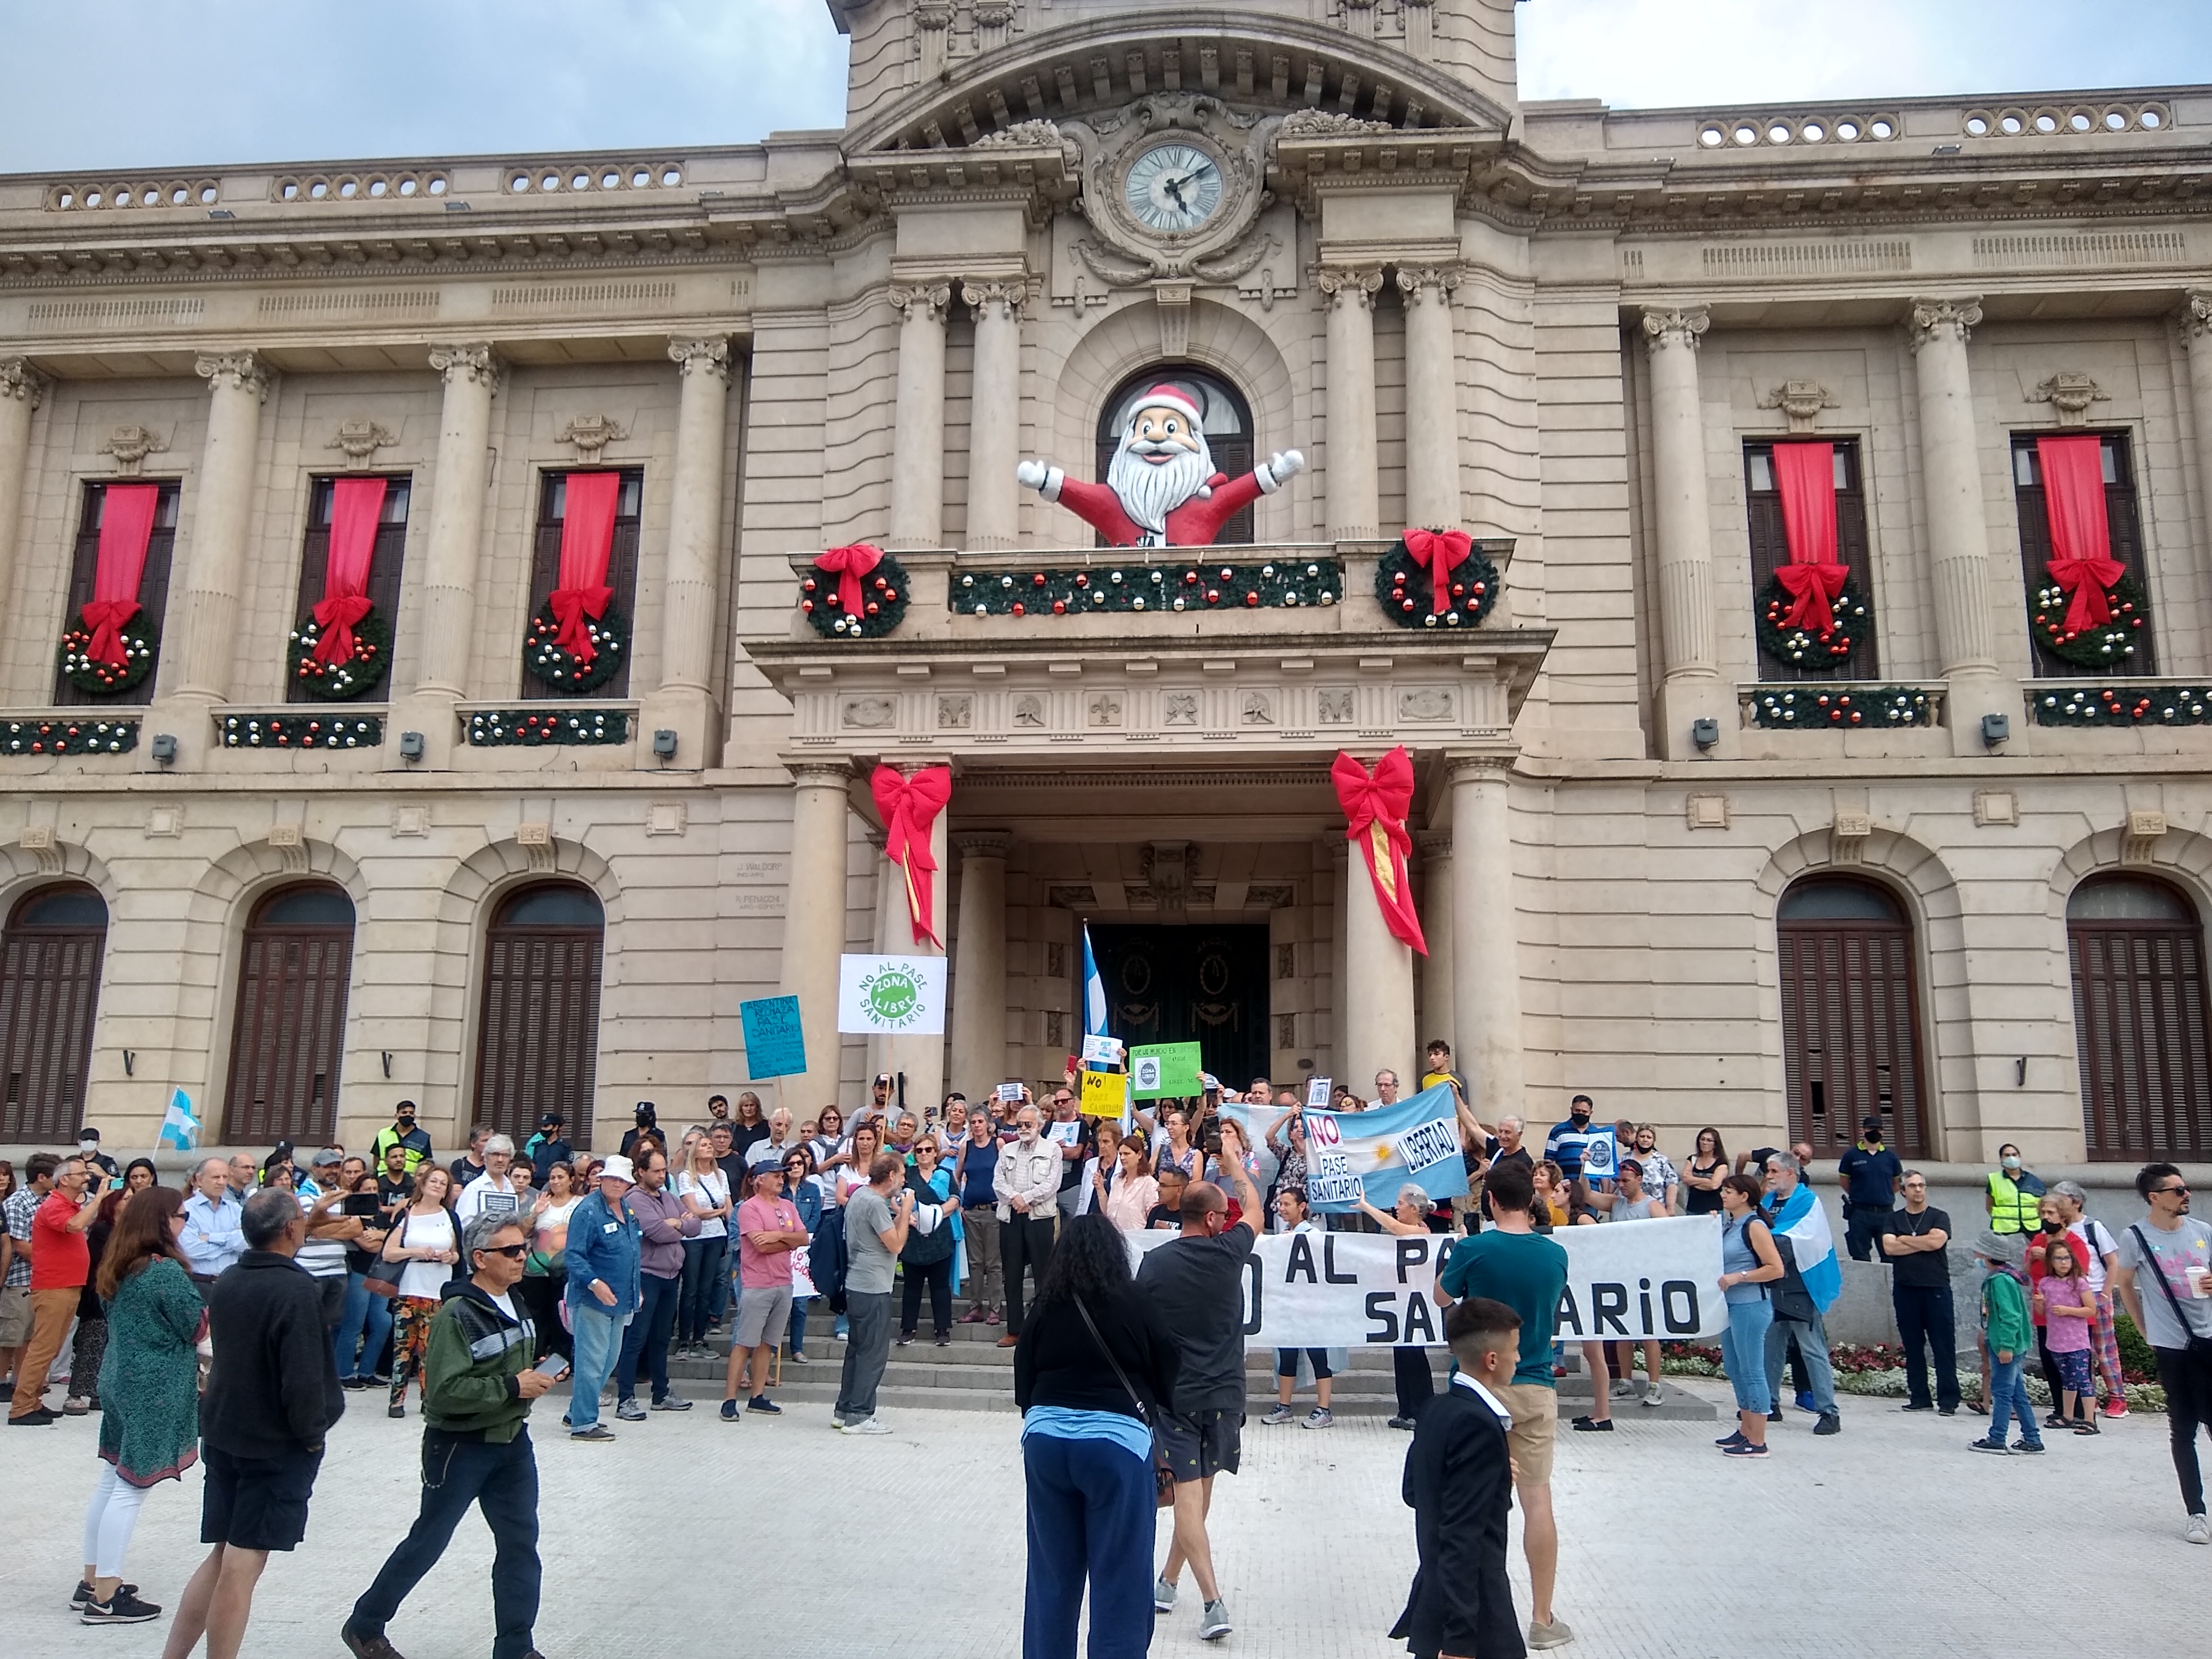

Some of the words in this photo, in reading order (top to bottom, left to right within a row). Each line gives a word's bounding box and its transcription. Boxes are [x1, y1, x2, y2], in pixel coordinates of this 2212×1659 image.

[744, 895, 780, 903] PENACCHI
[859, 974, 874, 991] NO
[879, 962, 895, 974] AL
[901, 963, 927, 990] PASE
[875, 975, 908, 992] ZONA
[754, 1004, 795, 1017] RECHAZA
[860, 999, 926, 1029] SANITARIO
[874, 995, 915, 1013] LIBRE
[751, 1023, 800, 1038] SANITARIO
[757, 1014, 788, 1027] PASE
[1309, 1115, 1339, 1148] NO
[1398, 1121, 1455, 1171] LIBERTAD
[1322, 1156, 1347, 1176] PASE
[1311, 1177, 1361, 1201] SANITARIO
[1285, 1233, 1358, 1284] AL
[1397, 1237, 1456, 1284] PA
